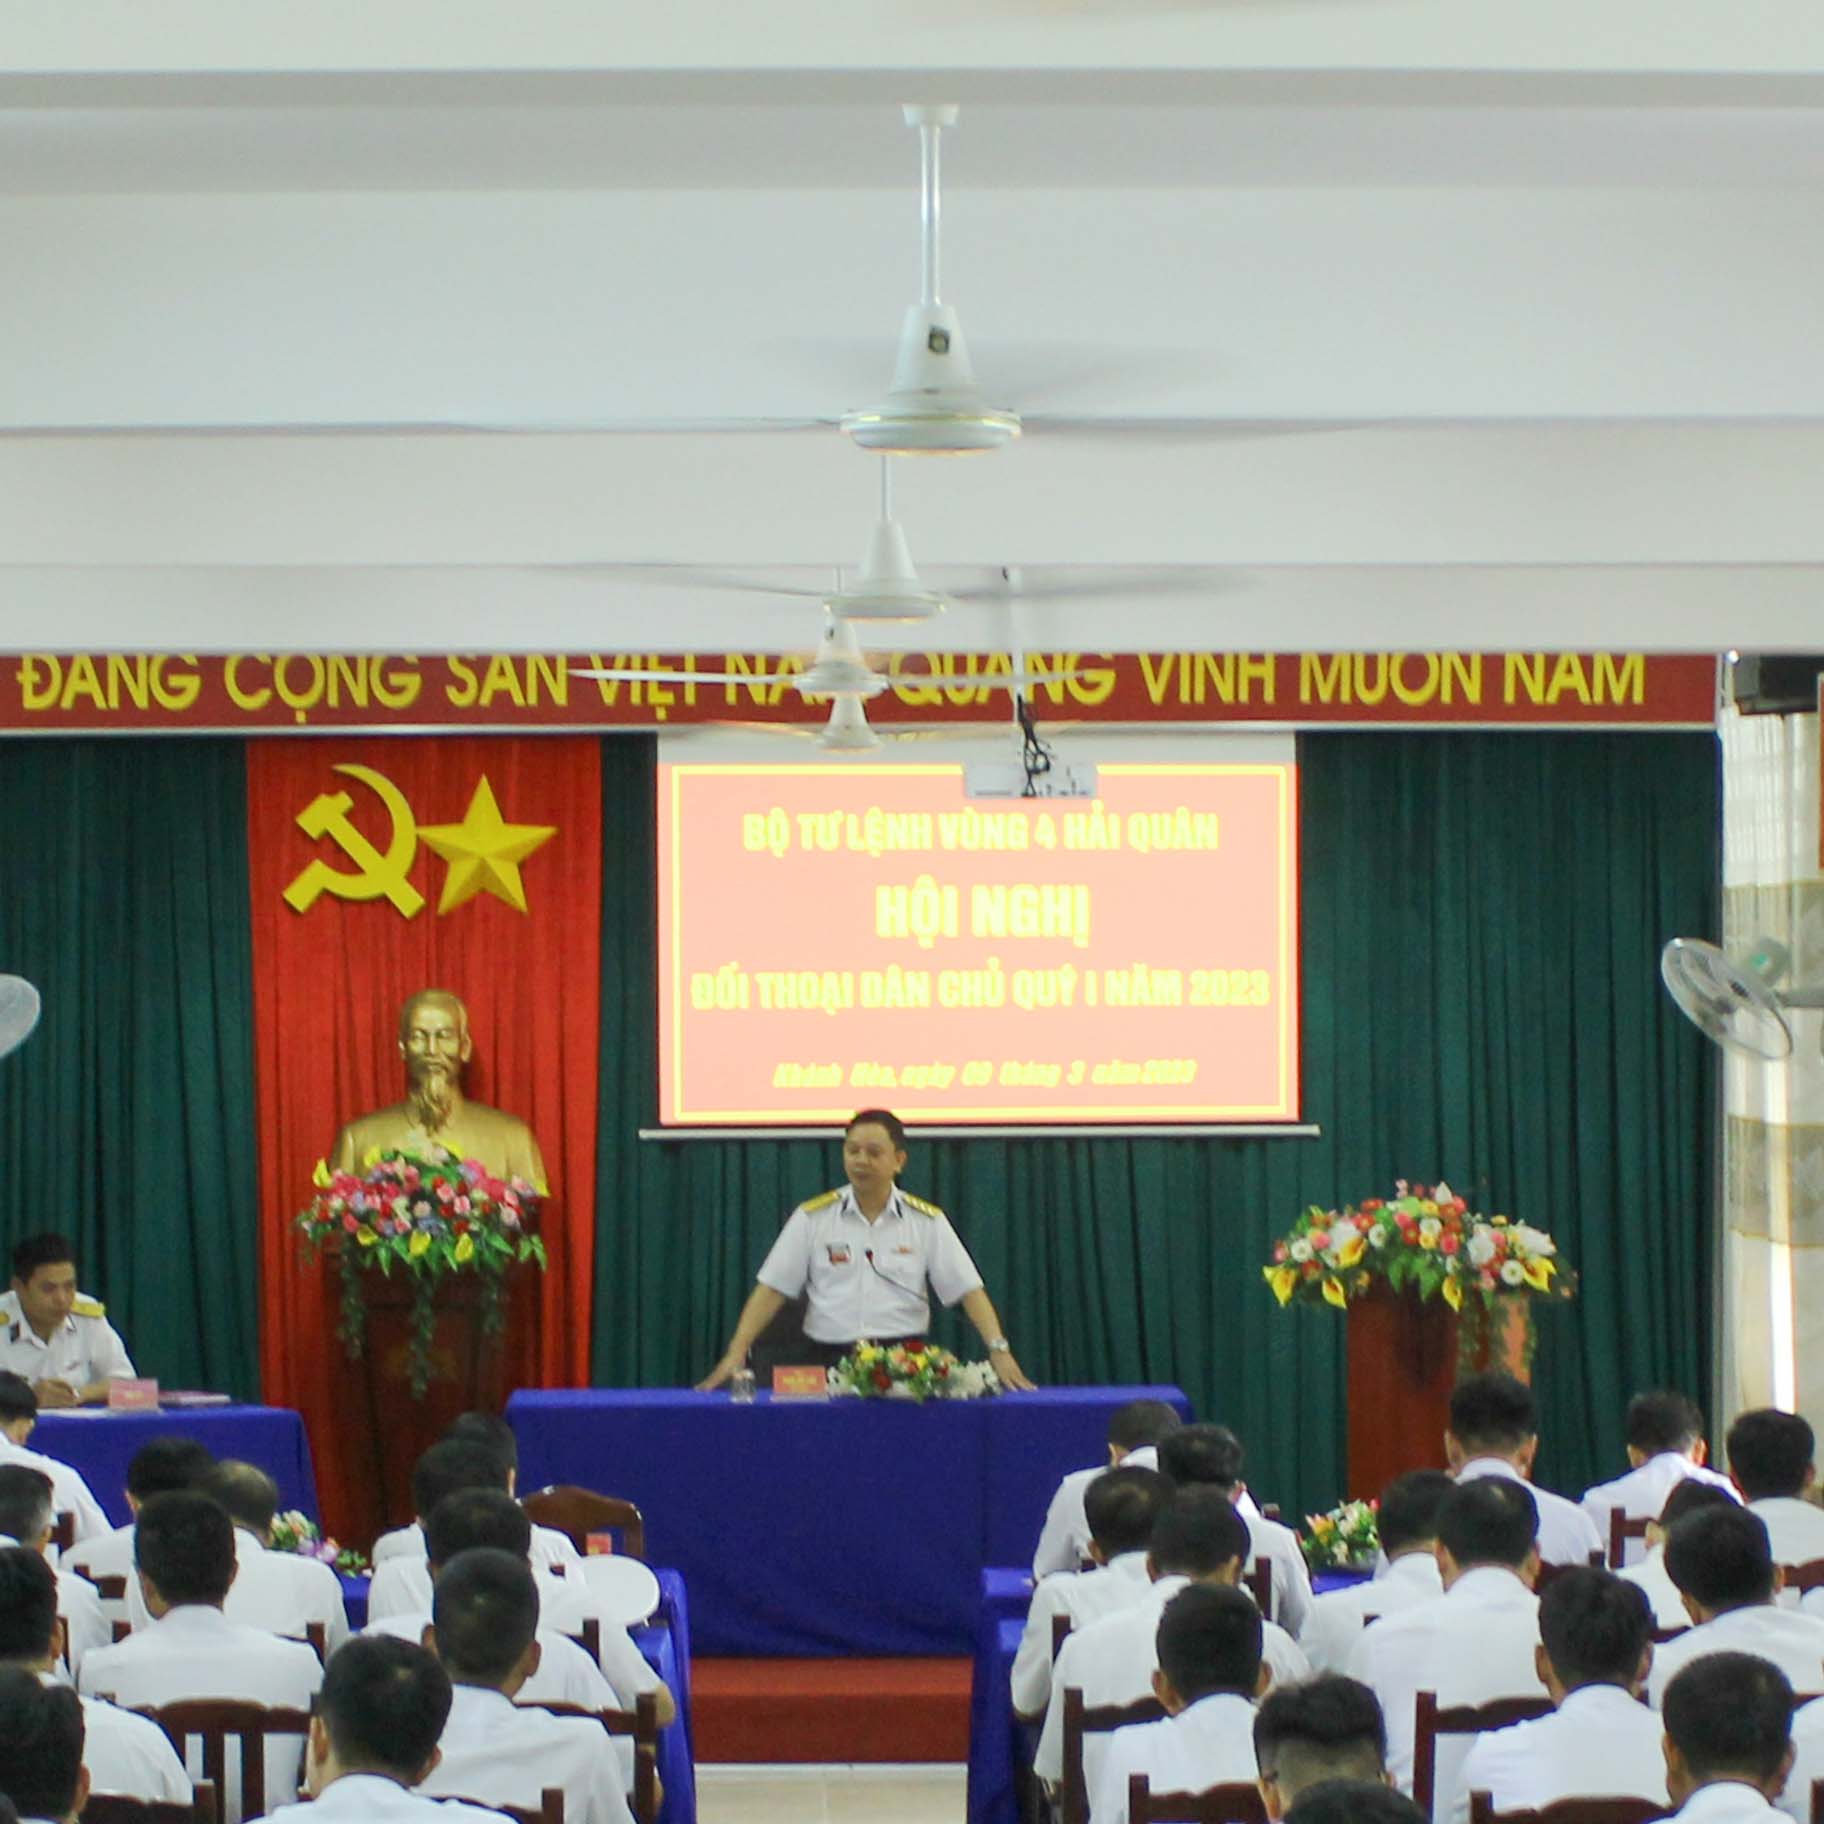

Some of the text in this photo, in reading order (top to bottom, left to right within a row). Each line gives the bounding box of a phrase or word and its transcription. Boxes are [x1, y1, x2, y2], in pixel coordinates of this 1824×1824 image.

[887, 654, 1116, 705] QUANG
[1139, 654, 1277, 704] VINH
[743, 800, 1219, 858] BỘ TƯ LỆNH VÙNG 4 HẢI QUÂN
[876, 874, 1090, 949] HỘI NGHỊ
[691, 961, 750, 1010] ĐỐI
[756, 971, 854, 1016] THOẠI
[860, 964, 931, 1009] DÂN
[937, 956, 1006, 1009] CHỦ
[1012, 963, 1077, 1010] QUÝ
[1084, 970, 1097, 1007] I
[1104, 963, 1183, 1007] NĂM
